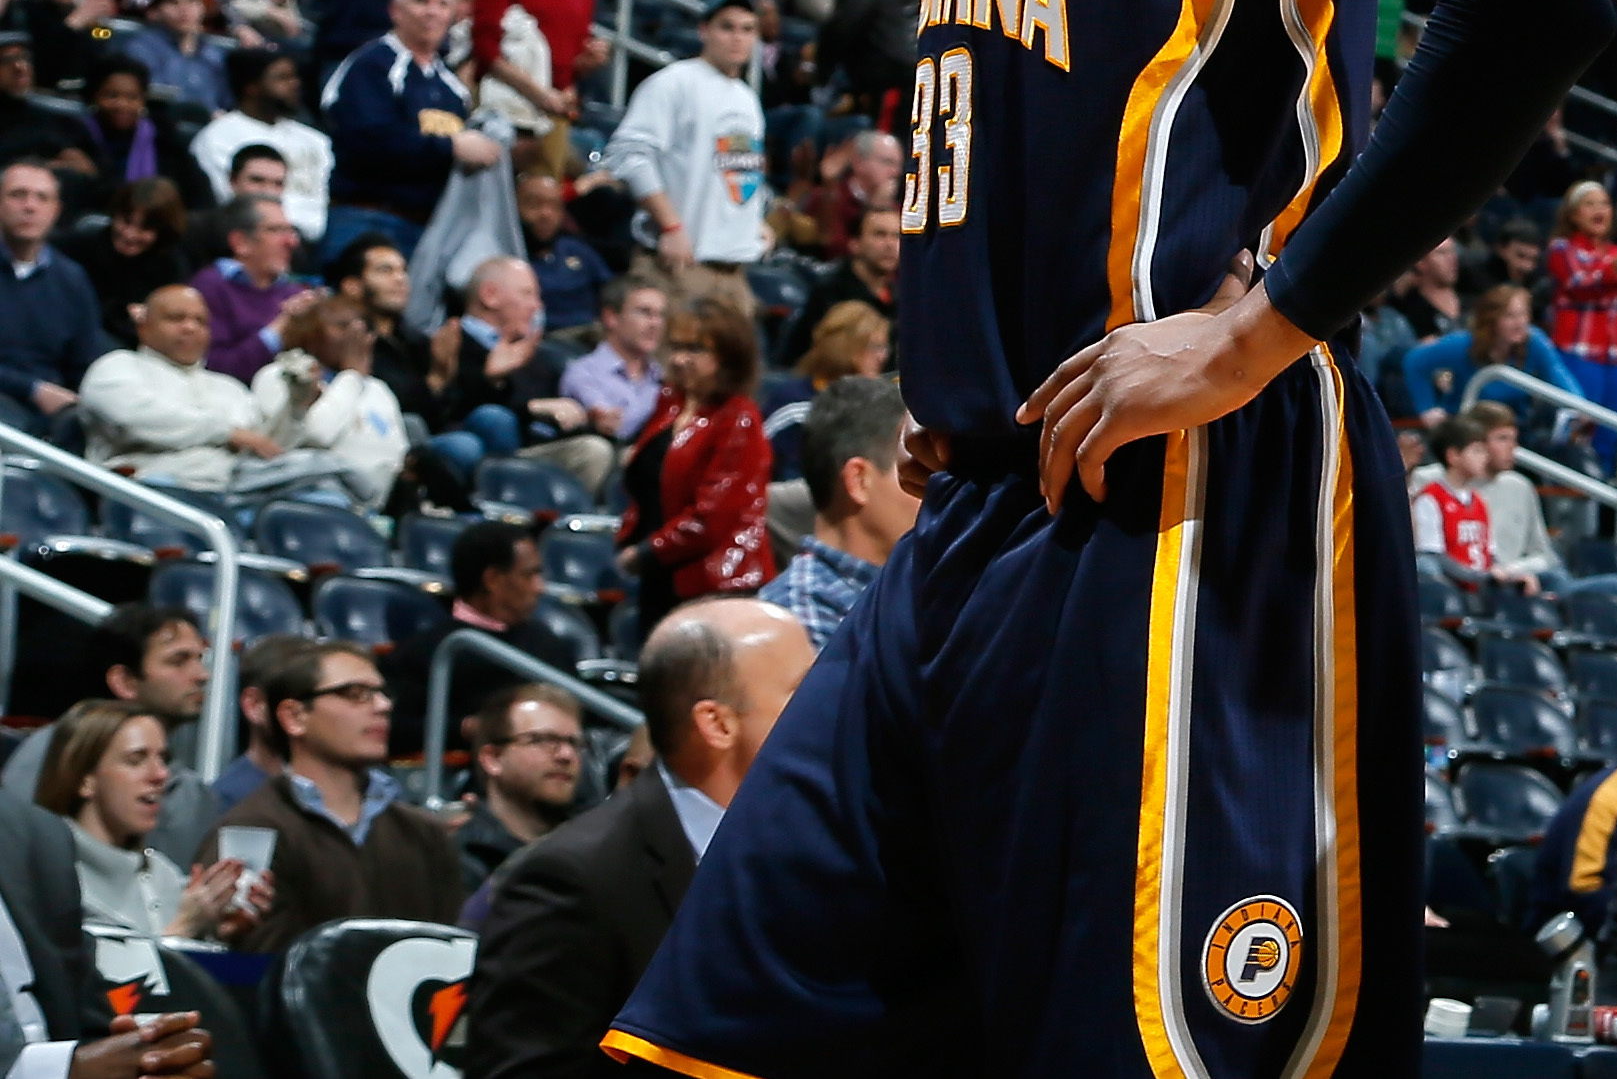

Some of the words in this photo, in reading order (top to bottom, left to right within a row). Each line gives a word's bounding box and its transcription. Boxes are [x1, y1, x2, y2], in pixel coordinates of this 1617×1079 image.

[900, 47, 973, 235] 33
[1211, 903, 1300, 950] INDIANA
[1211, 977, 1291, 1016] PACERS
